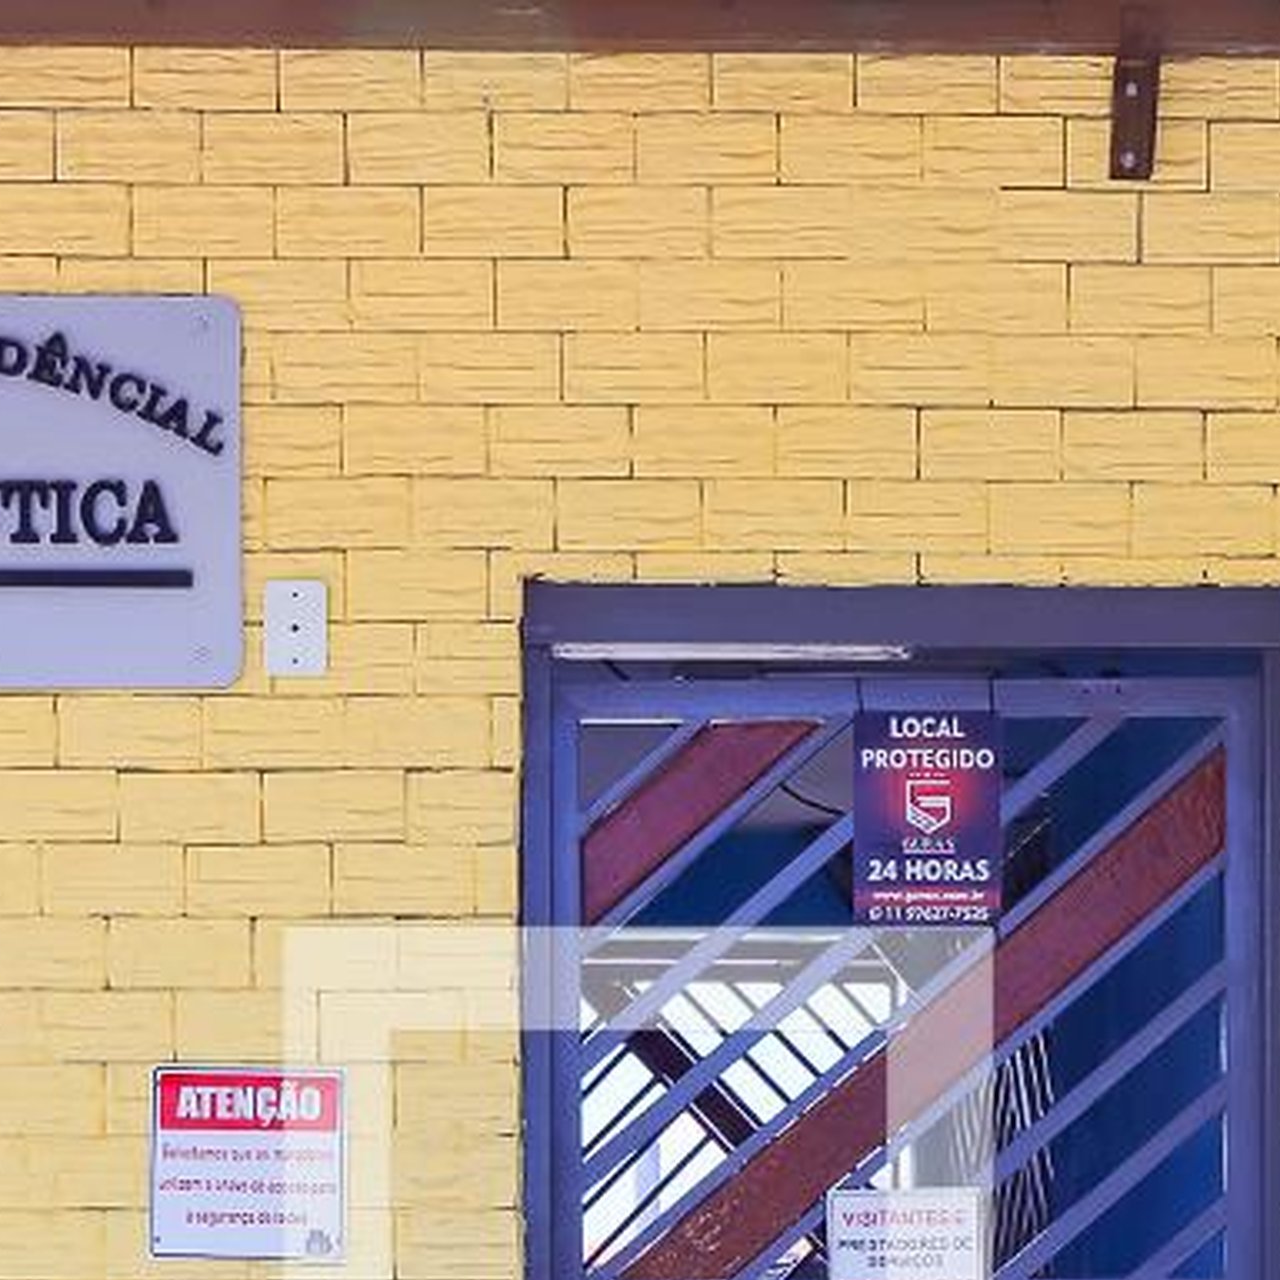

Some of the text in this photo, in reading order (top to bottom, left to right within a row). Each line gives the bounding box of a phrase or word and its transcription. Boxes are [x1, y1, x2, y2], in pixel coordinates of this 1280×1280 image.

[889, 716, 966, 738] LOCAL
[861, 748, 995, 769] PROTEGIDO
[867, 858, 991, 881] 24 HORAS
[176, 1079, 322, 1128] ATENÇÃO
